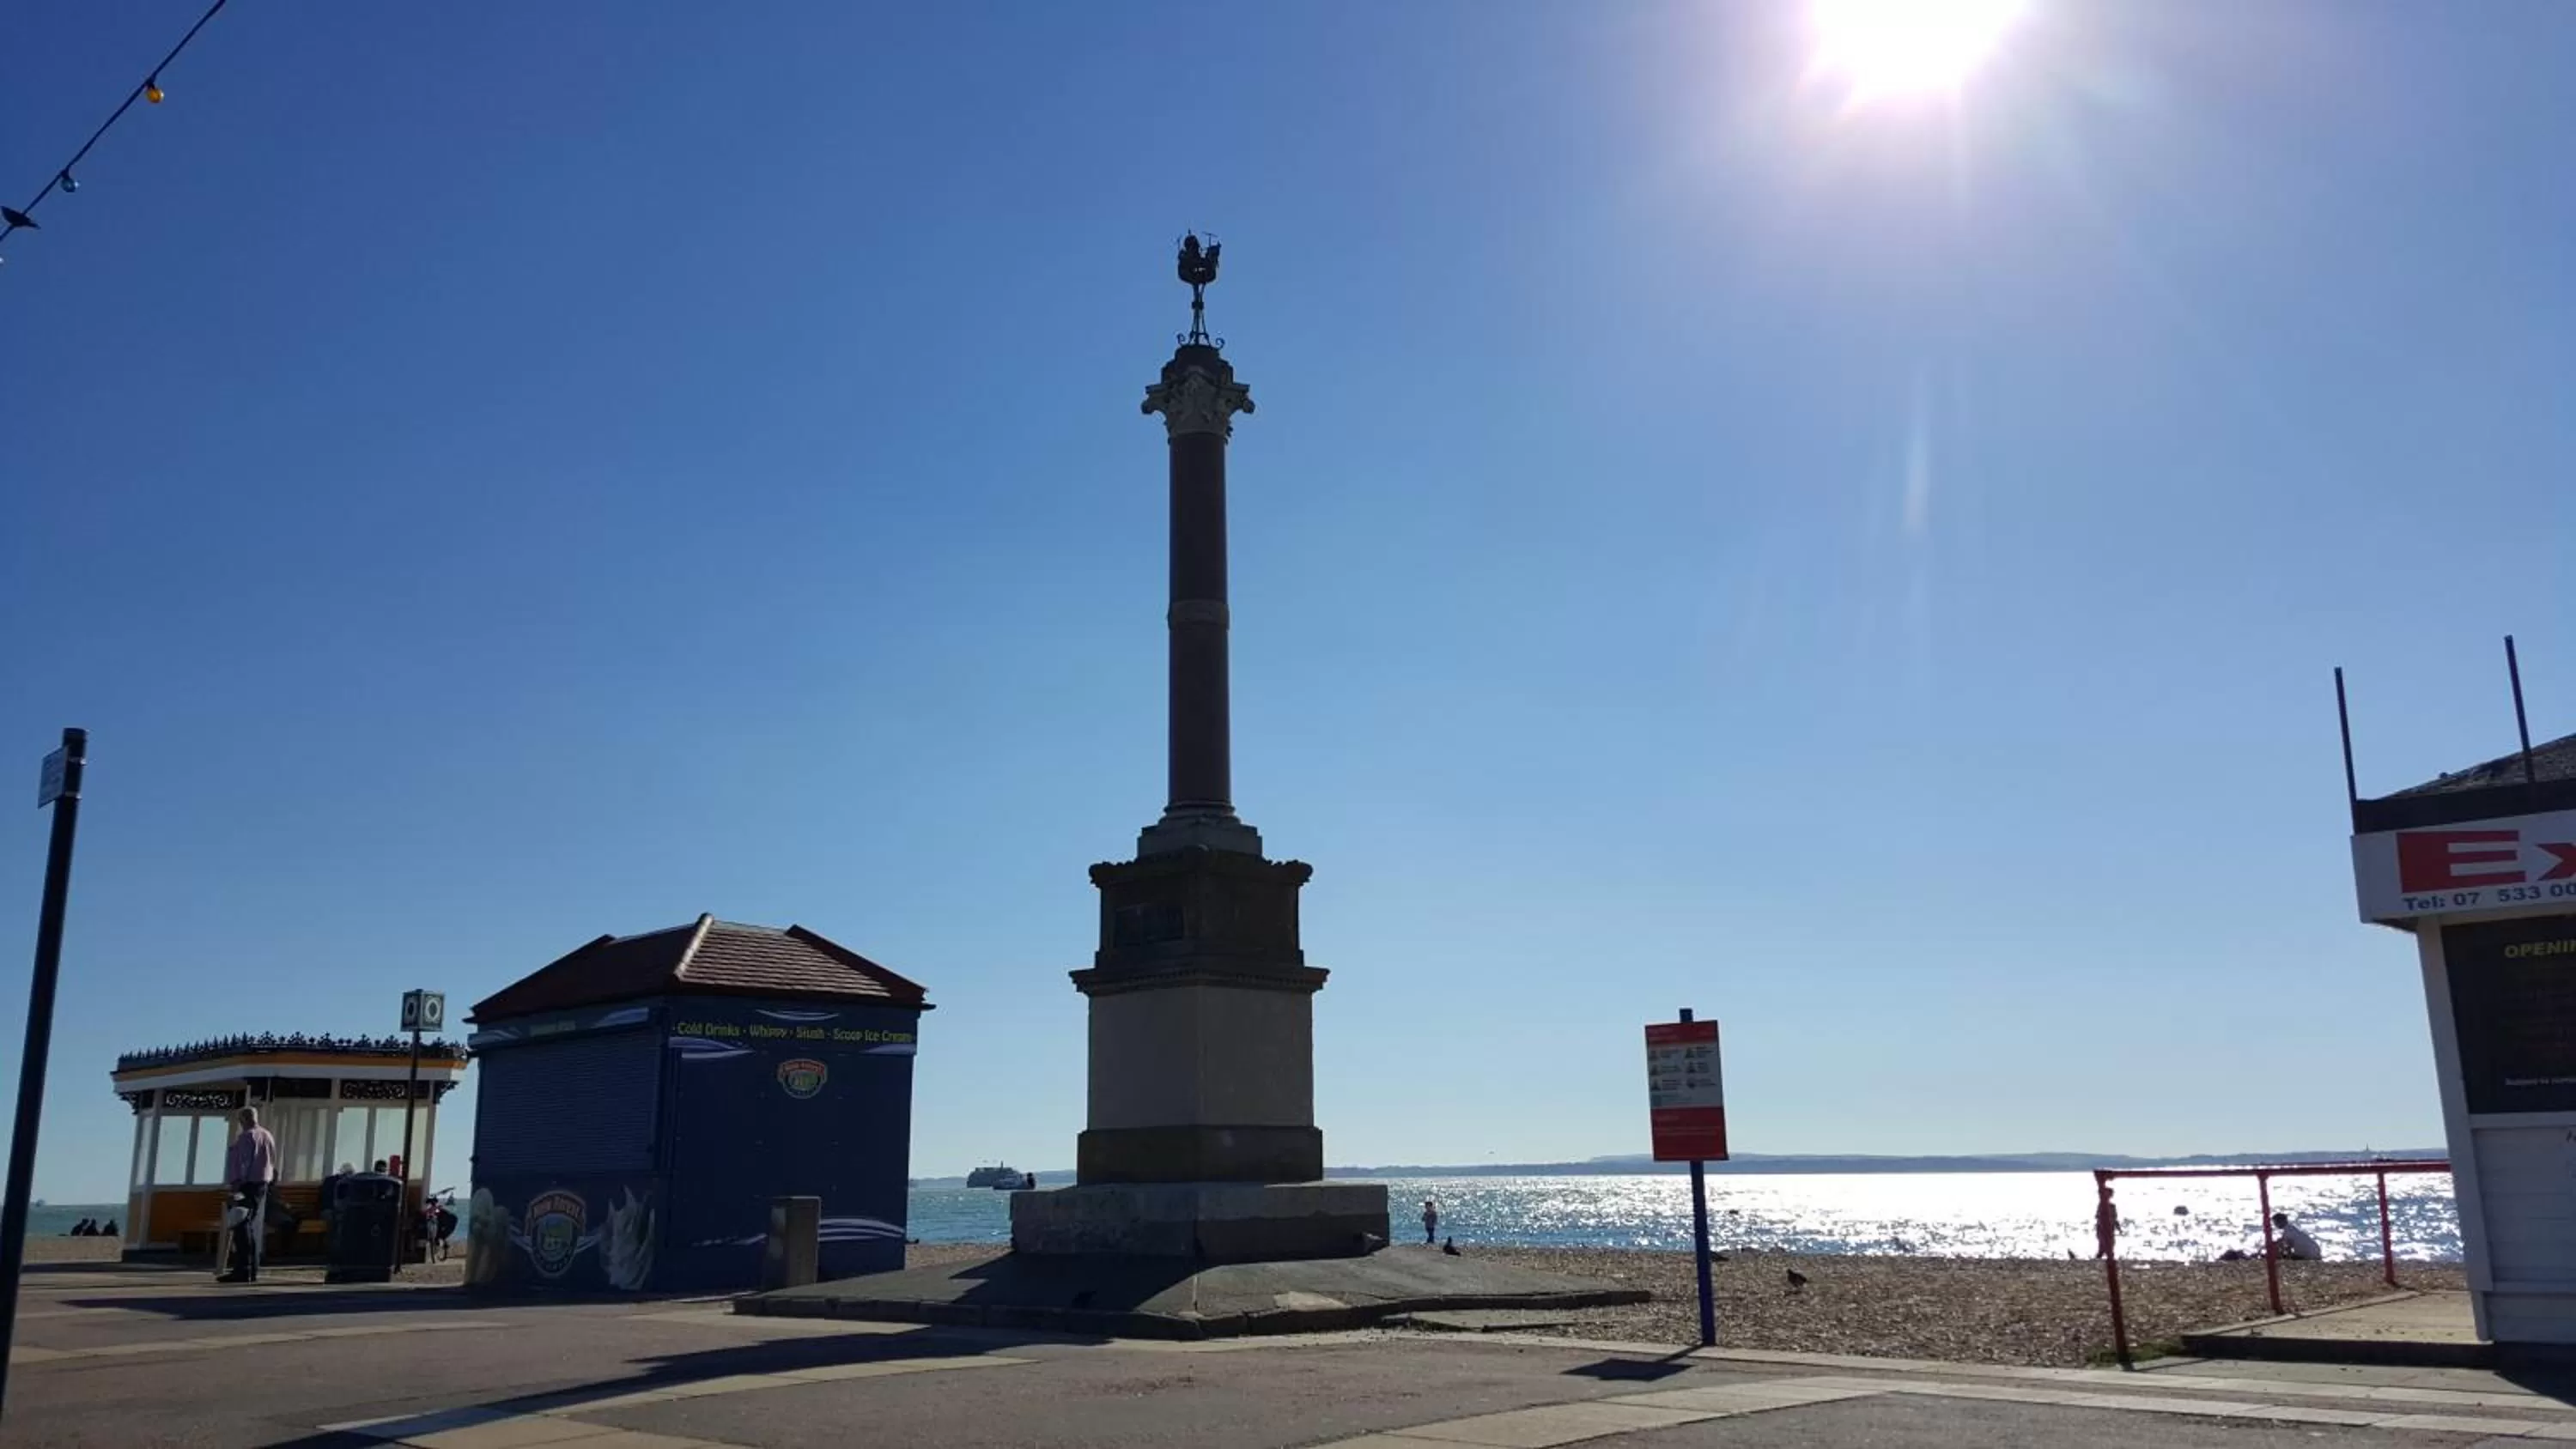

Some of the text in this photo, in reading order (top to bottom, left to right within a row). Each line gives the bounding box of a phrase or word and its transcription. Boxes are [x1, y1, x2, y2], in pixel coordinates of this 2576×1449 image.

[2402, 895, 2445, 910] Tel:
[2452, 892, 2481, 906] 07
[2497, 885, 2541, 902] 533
[677, 1022, 702, 1035] Cold
